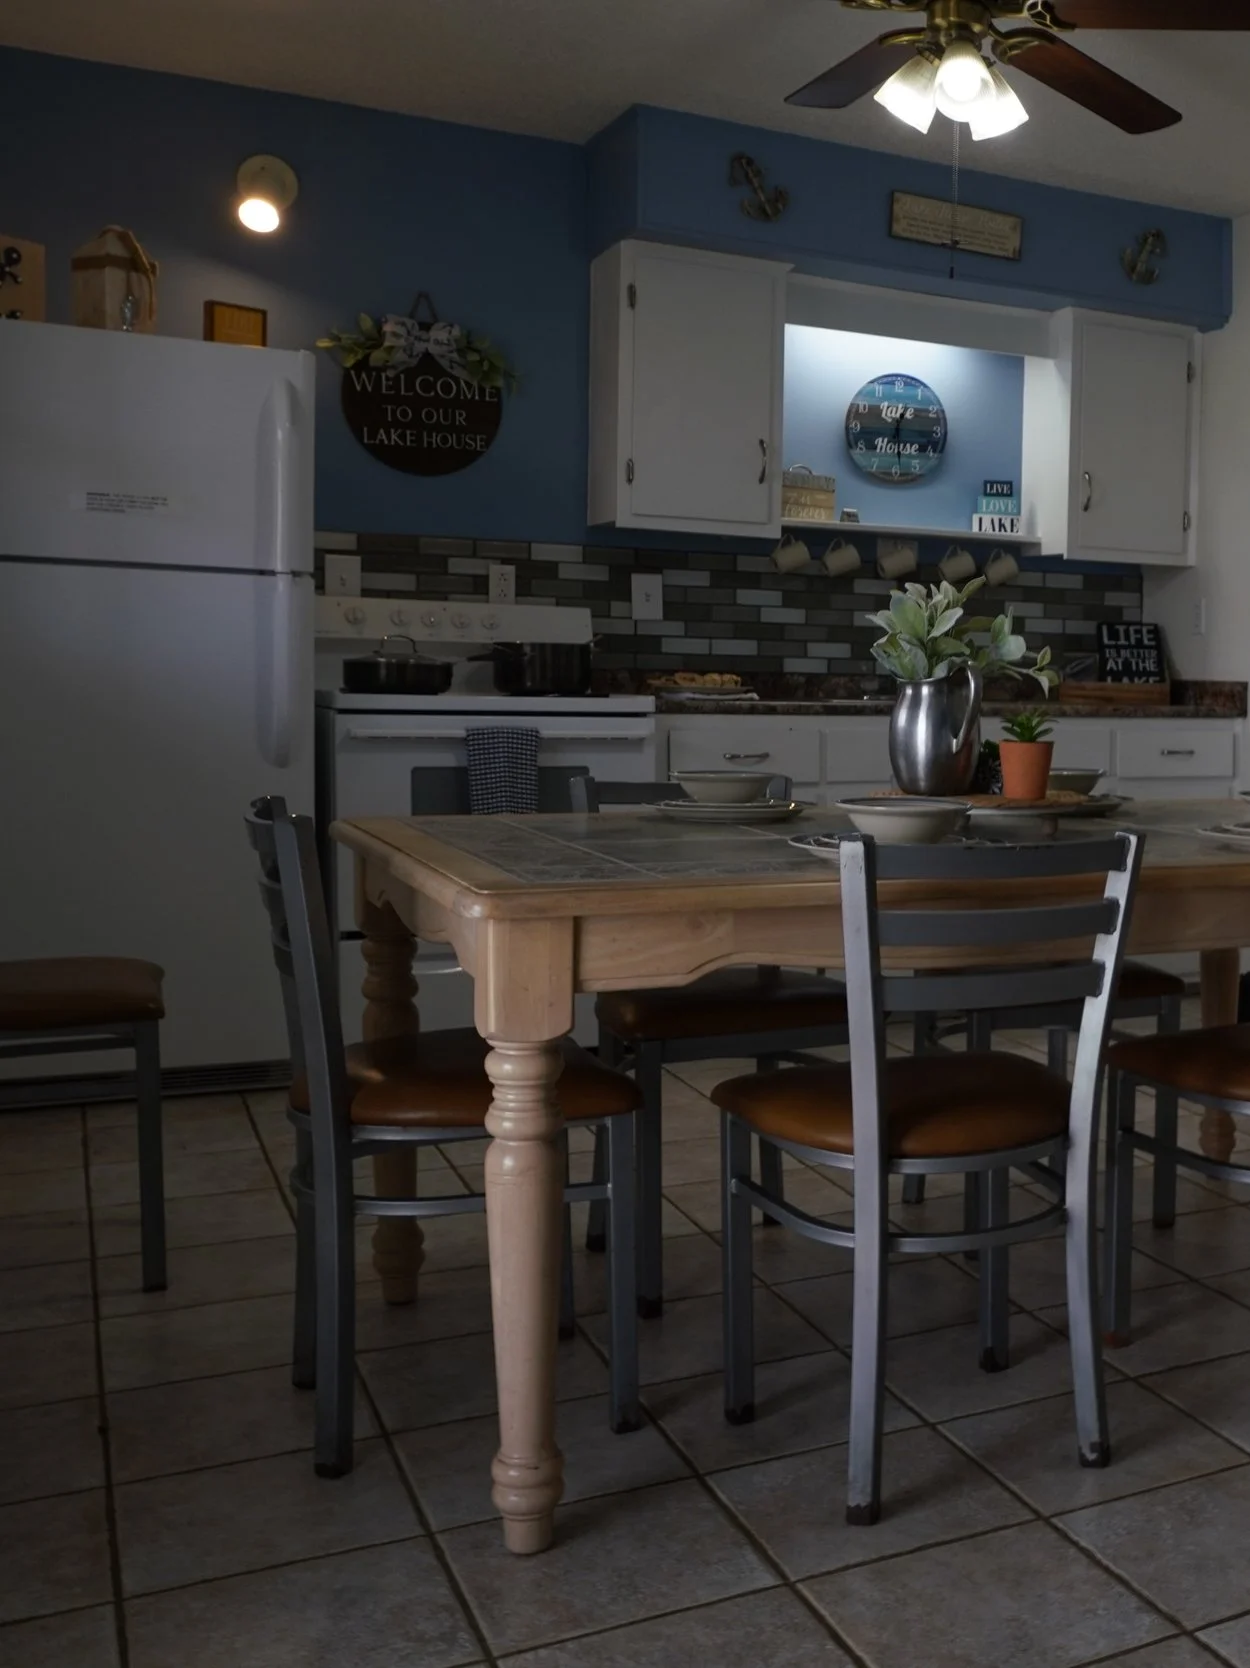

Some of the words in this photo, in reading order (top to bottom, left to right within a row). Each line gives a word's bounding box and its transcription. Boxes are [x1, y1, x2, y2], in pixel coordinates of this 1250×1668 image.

[350, 370, 498, 402] WELCOME
[895, 379, 904, 393] 12
[858, 402, 869, 414] 10
[928, 405, 938, 418] 2
[382, 404, 412, 423] TO
[421, 407, 467, 426] OUR
[852, 421, 861, 433] 9
[932, 426, 941, 439] 3
[363, 426, 417, 447] LAKE
[423, 431, 489, 452] HOUSE
[874, 436, 919, 455] House
[856, 440, 866, 453] 8
[926, 445, 934, 457] 4
[871, 458, 879, 471] 7
[911, 460, 921, 473] 5
[891, 465, 900, 478] 6
[986, 483, 1011, 495] LIVE
[982, 499, 1017, 513] LOVE
[978, 517, 1020, 533] LAKE
[1101, 624, 1157, 646] LIFE
[1106, 659, 1126, 672] AT
[1130, 659, 1159, 672] THE
